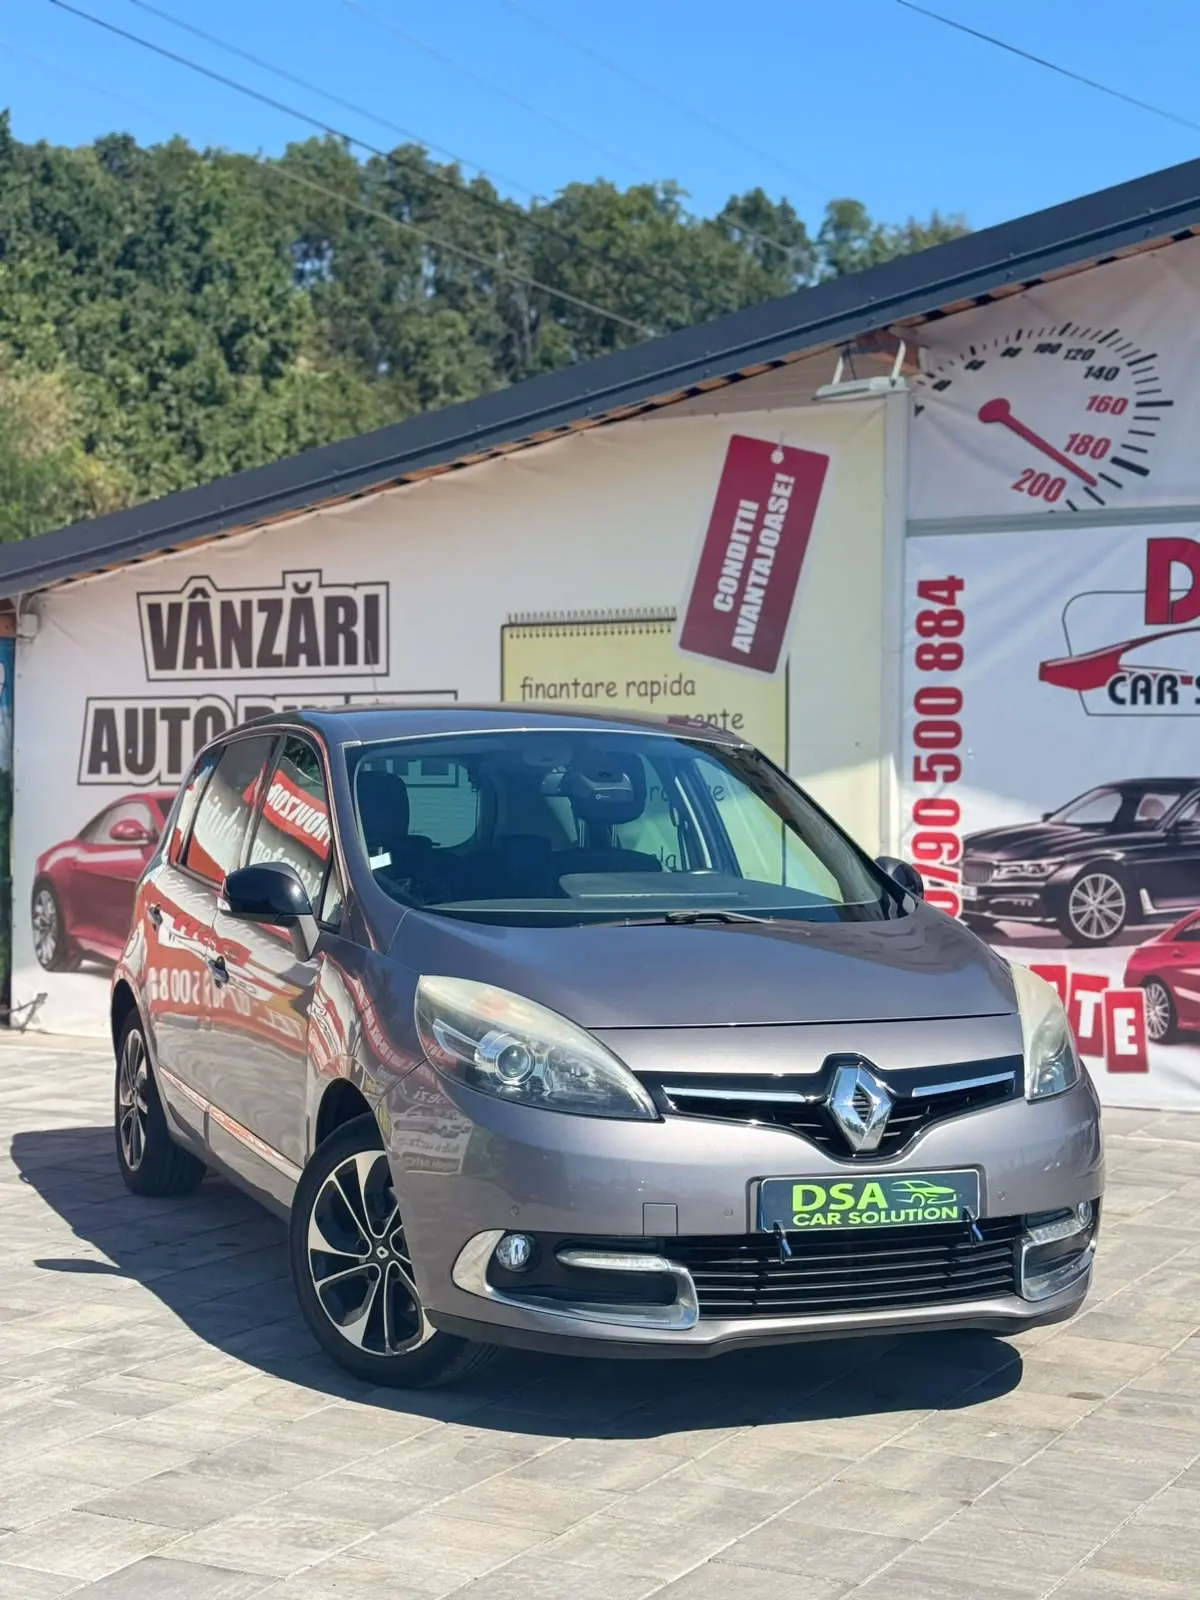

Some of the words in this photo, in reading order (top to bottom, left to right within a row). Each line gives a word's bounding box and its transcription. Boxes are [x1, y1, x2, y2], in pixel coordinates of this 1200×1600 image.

[1063, 347, 1096, 361] 120
[1083, 365, 1120, 382] 140
[1086, 394, 1129, 416] 160
[1064, 432, 1112, 460] 180
[1011, 467, 1067, 503] 200
[713, 499, 759, 612] CONDITII
[731, 472, 796, 654] AVANTAJOASE!
[147, 581, 380, 671] VÂNZĂRI
[915, 575, 965, 672] 884
[520, 676, 618, 701] finantare
[626, 673, 696, 704] rapida
[1108, 674, 1179, 706] CAR
[913, 686, 964, 783] 500
[792, 1182, 888, 1212] DSA
[793, 1212, 842, 1226] CAR
[848, 1206, 958, 1224] SOLUTION
